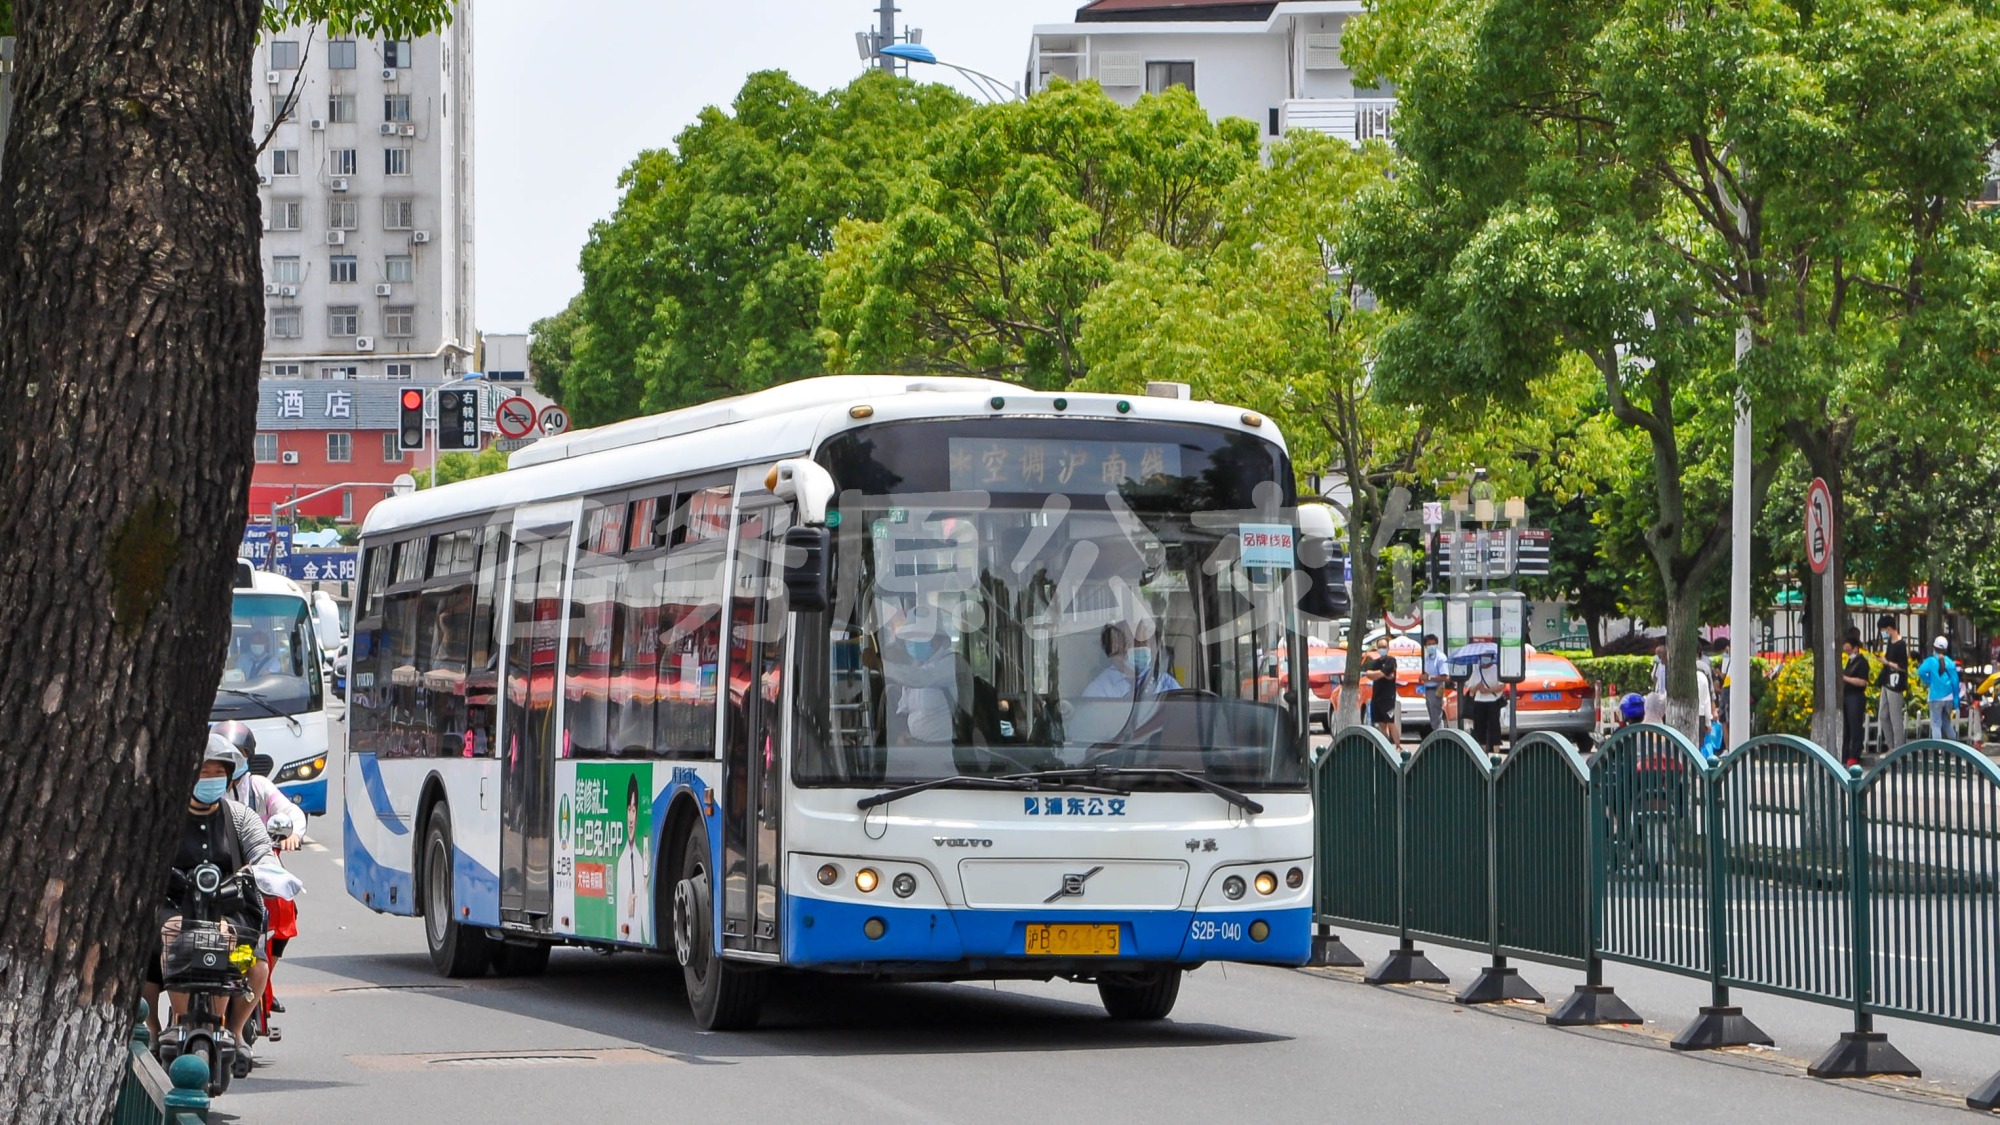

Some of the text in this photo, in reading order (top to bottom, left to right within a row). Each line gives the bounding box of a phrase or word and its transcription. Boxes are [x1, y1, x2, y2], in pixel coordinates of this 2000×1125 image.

[276, 389, 351, 419] 酒店
[462, 391, 475, 447] 右转控制
[544, 412, 563, 428] 40
[247, 530, 289, 538] lenvo
[1243, 532, 1291, 548] 品牌线路
[302, 558, 356, 580] 金太阳
[576, 778, 609, 815] 装修就上
[1044, 796, 1126, 816] 浦东公交
[574, 818, 624, 857] 土巴兔APP
[932, 836, 993, 848] VOLVO
[1191, 920, 1242, 941] S2B-040
